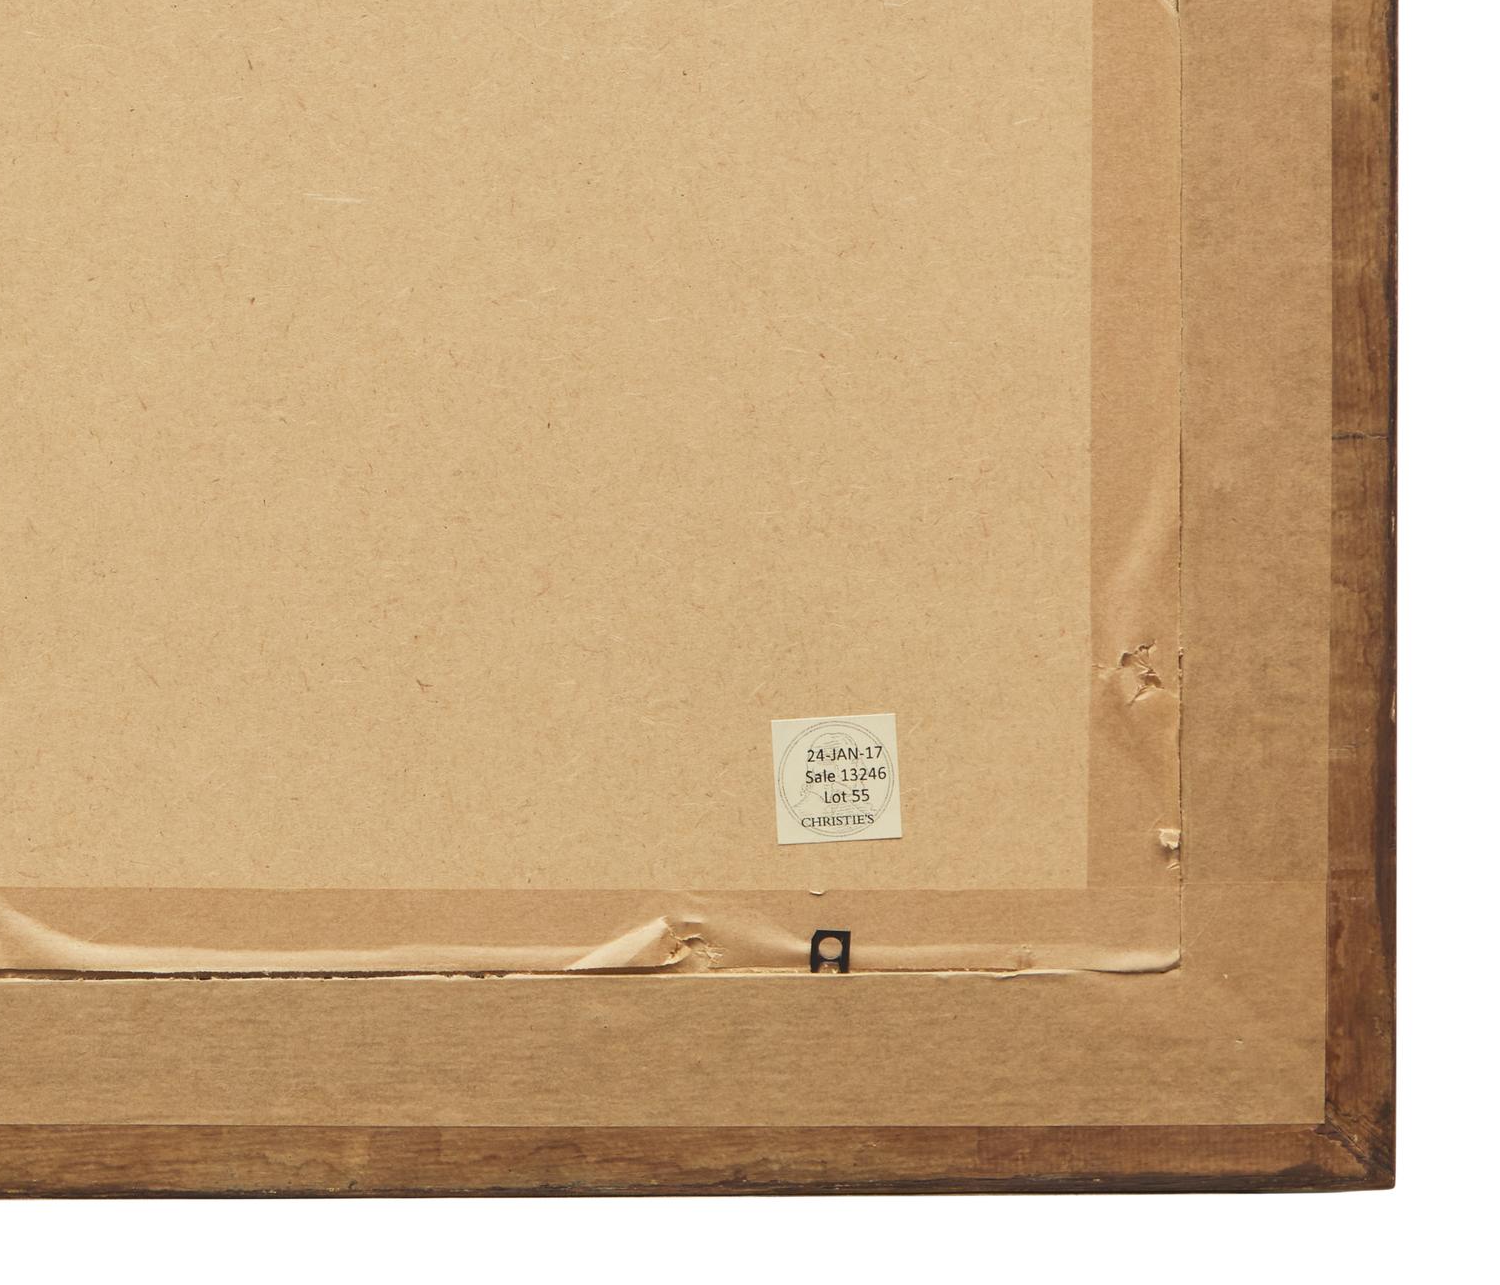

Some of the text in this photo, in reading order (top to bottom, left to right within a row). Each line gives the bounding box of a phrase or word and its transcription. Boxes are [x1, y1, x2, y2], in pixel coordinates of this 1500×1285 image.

[807, 746, 883, 762] 24-JAN-17
[805, 766, 887, 784] Sale 13246
[824, 789, 870, 804] Lot 55
[801, 814, 875, 828] CHRISTIE'S
